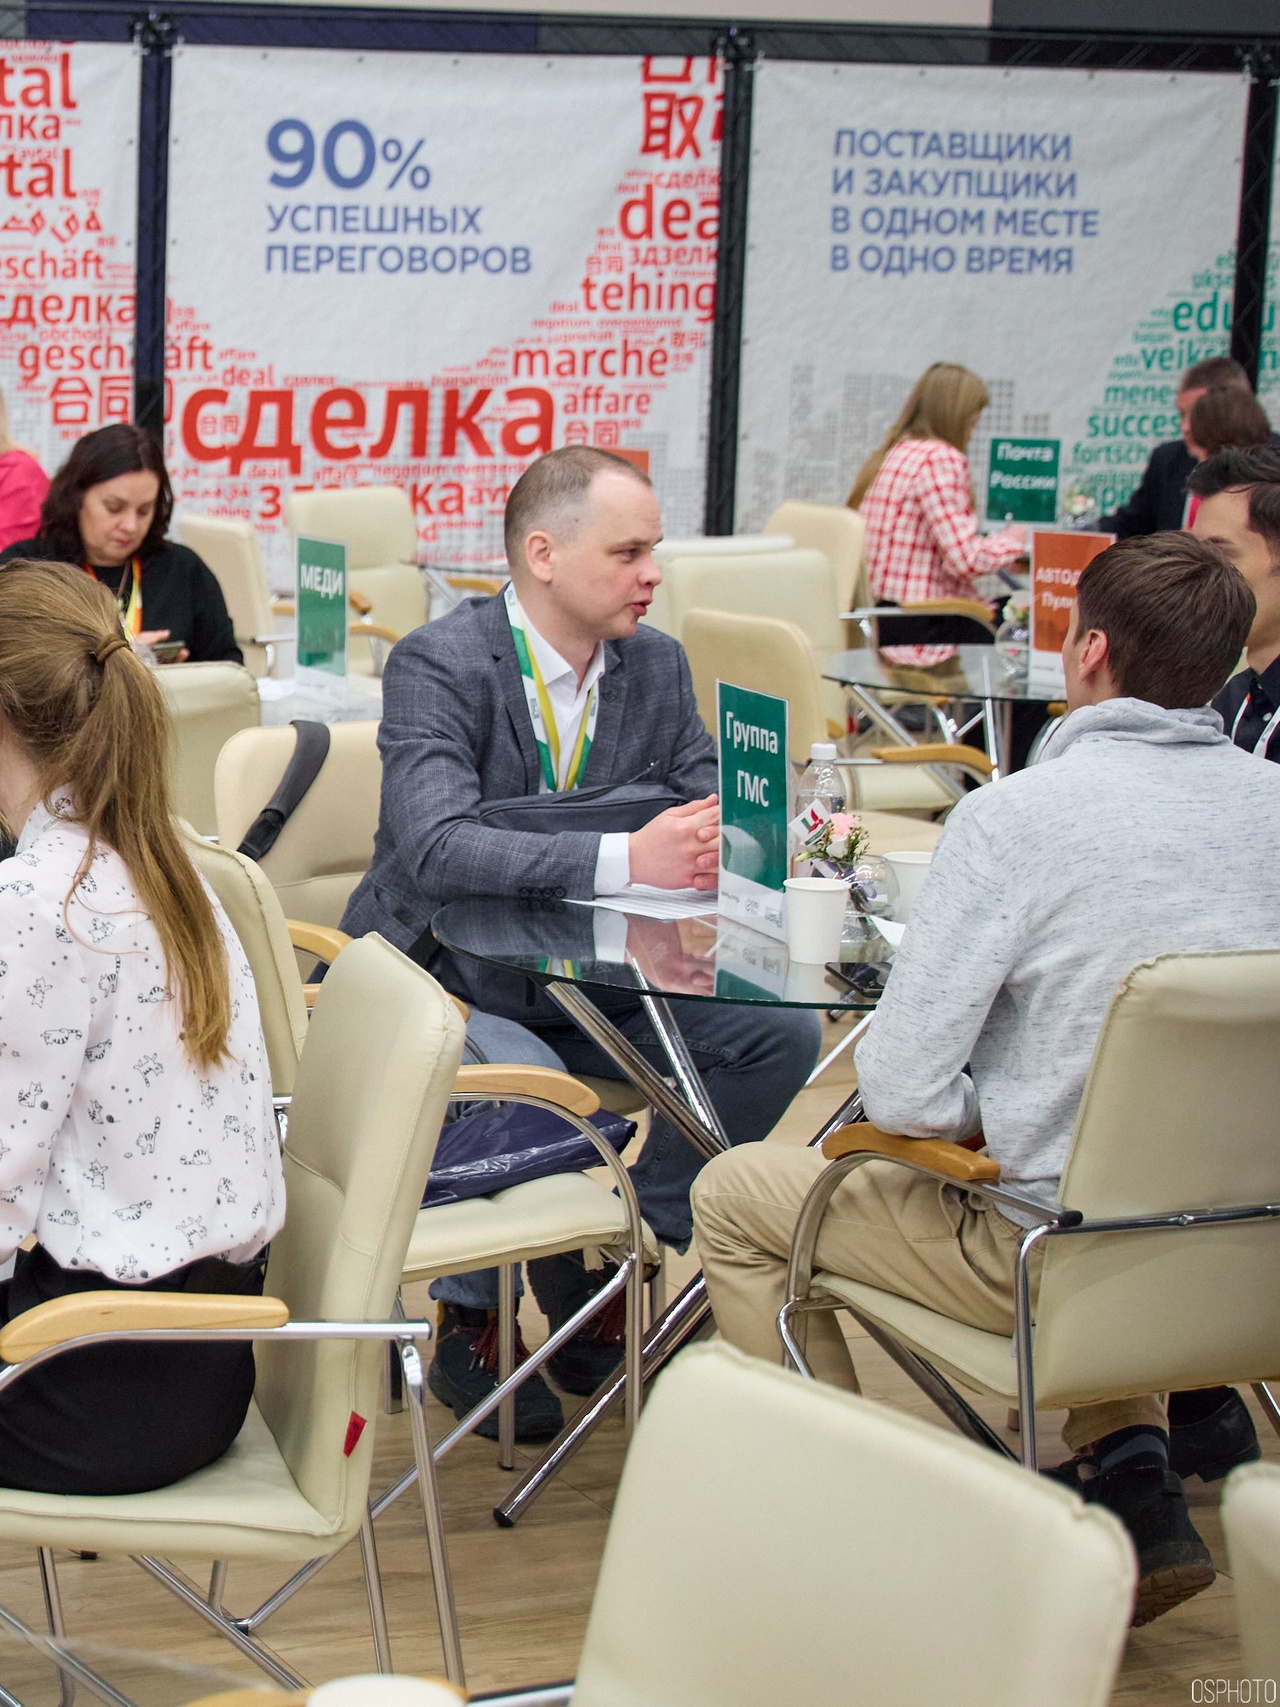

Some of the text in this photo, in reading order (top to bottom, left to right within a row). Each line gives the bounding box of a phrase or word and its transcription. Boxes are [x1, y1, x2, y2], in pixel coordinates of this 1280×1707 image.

[266, 119, 431, 190] 90%
[834, 129, 1072, 163] ПОСТАВЩИКИ
[832, 169, 1077, 202] И ЗАКУПЩИКИ
[268, 204, 482, 235] УСПЕШНЫХ
[831, 207, 1100, 238] В ОДНОМ МЕСТЕ
[266, 245, 532, 275] ПЕРЕГОВОРОВ
[831, 246, 1073, 276] В ОДНО ВРЕМЯ
[580, 271, 715, 323] tehing
[513, 338, 668, 378] marché
[222, 362, 274, 388] deal
[563, 385, 652, 416] affare
[181, 385, 555, 477] сделка
[997, 442, 1054, 463] Почта
[990, 470, 1057, 491] России
[300, 563, 344, 600] МЕДИ
[726, 711, 779, 755] Группа
[737, 770, 770, 808] ГМС
